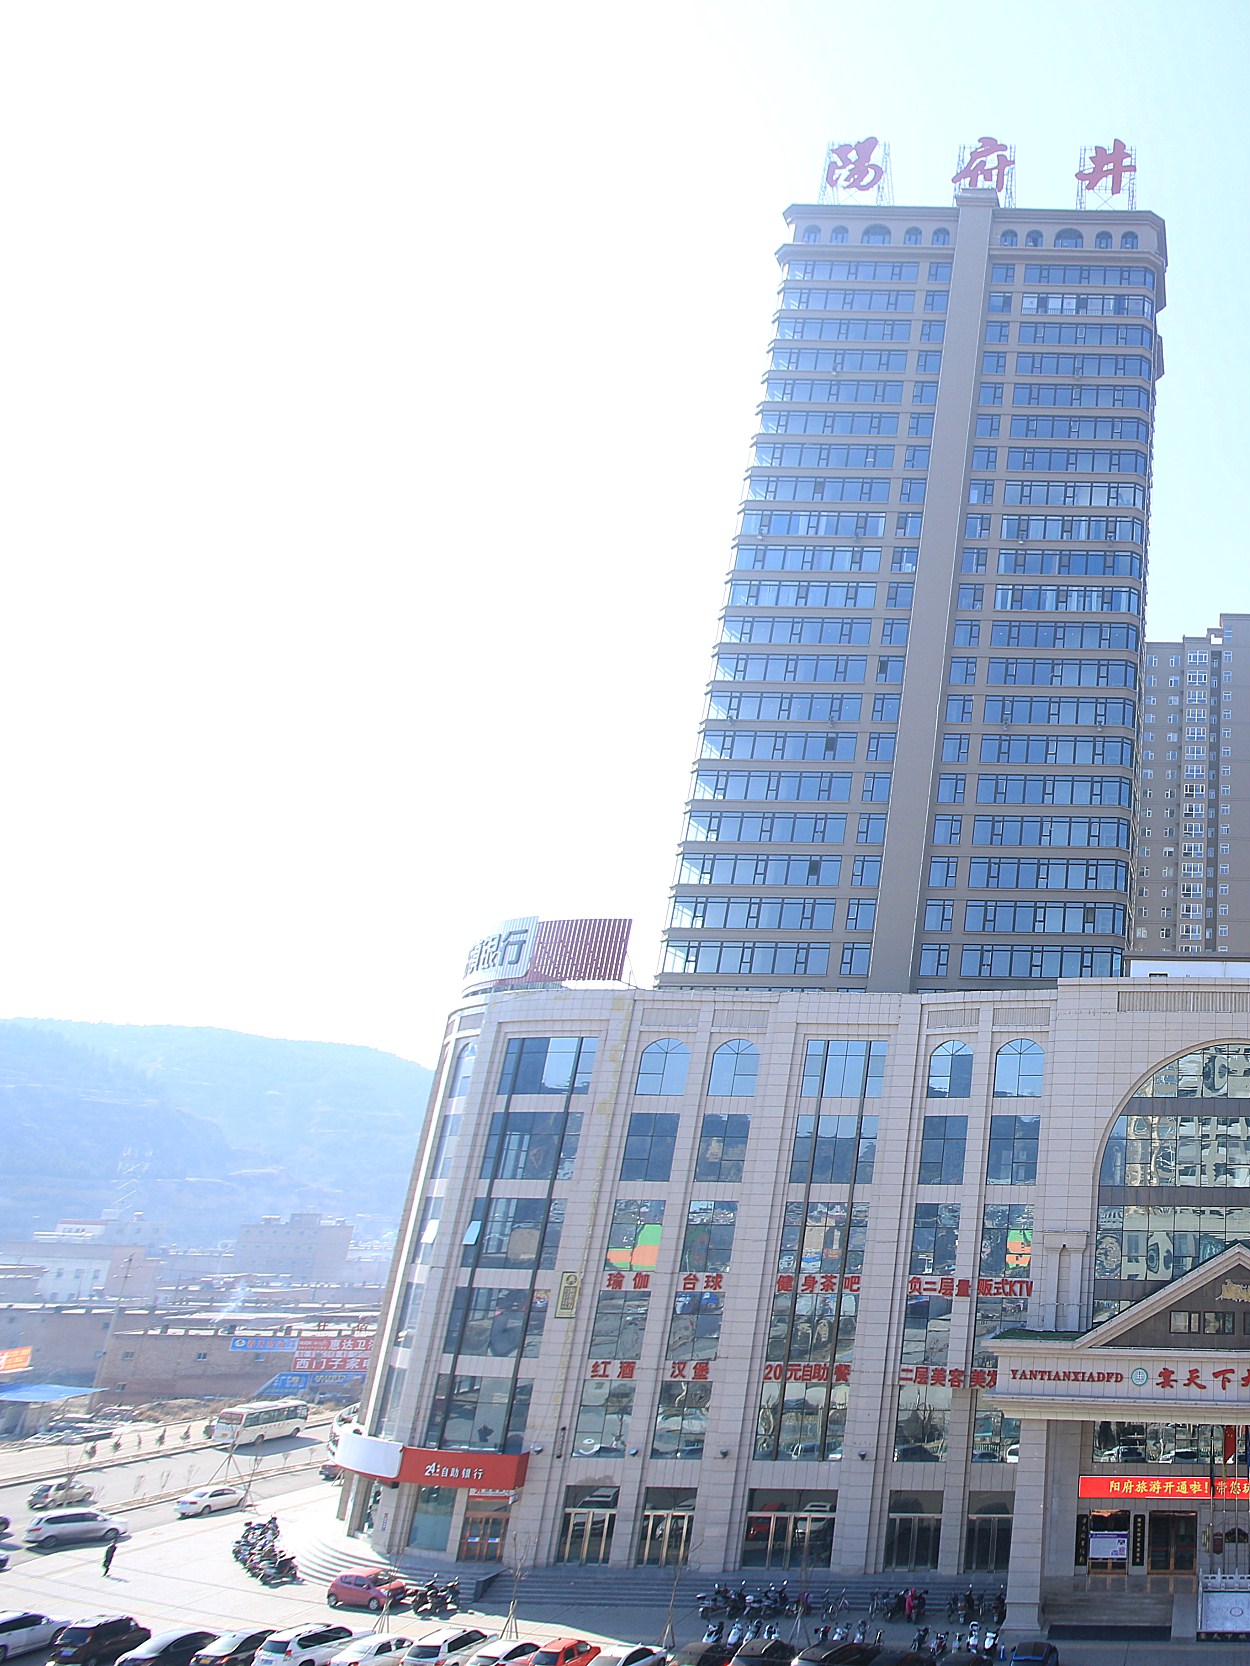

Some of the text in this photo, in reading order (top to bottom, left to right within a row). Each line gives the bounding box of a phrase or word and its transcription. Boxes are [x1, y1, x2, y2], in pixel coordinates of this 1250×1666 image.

[607, 1272, 650, 1290] 瑜伽
[683, 1273, 723, 1291] 台球
[776, 1274, 861, 1293] 健身茶吧
[591, 1361, 636, 1379] 红酒
[671, 1361, 711, 1380] 汉堡
[763, 1363, 852, 1383] 20元自助餐
[1010, 1369, 1124, 1384] YANTIANXIADFD
